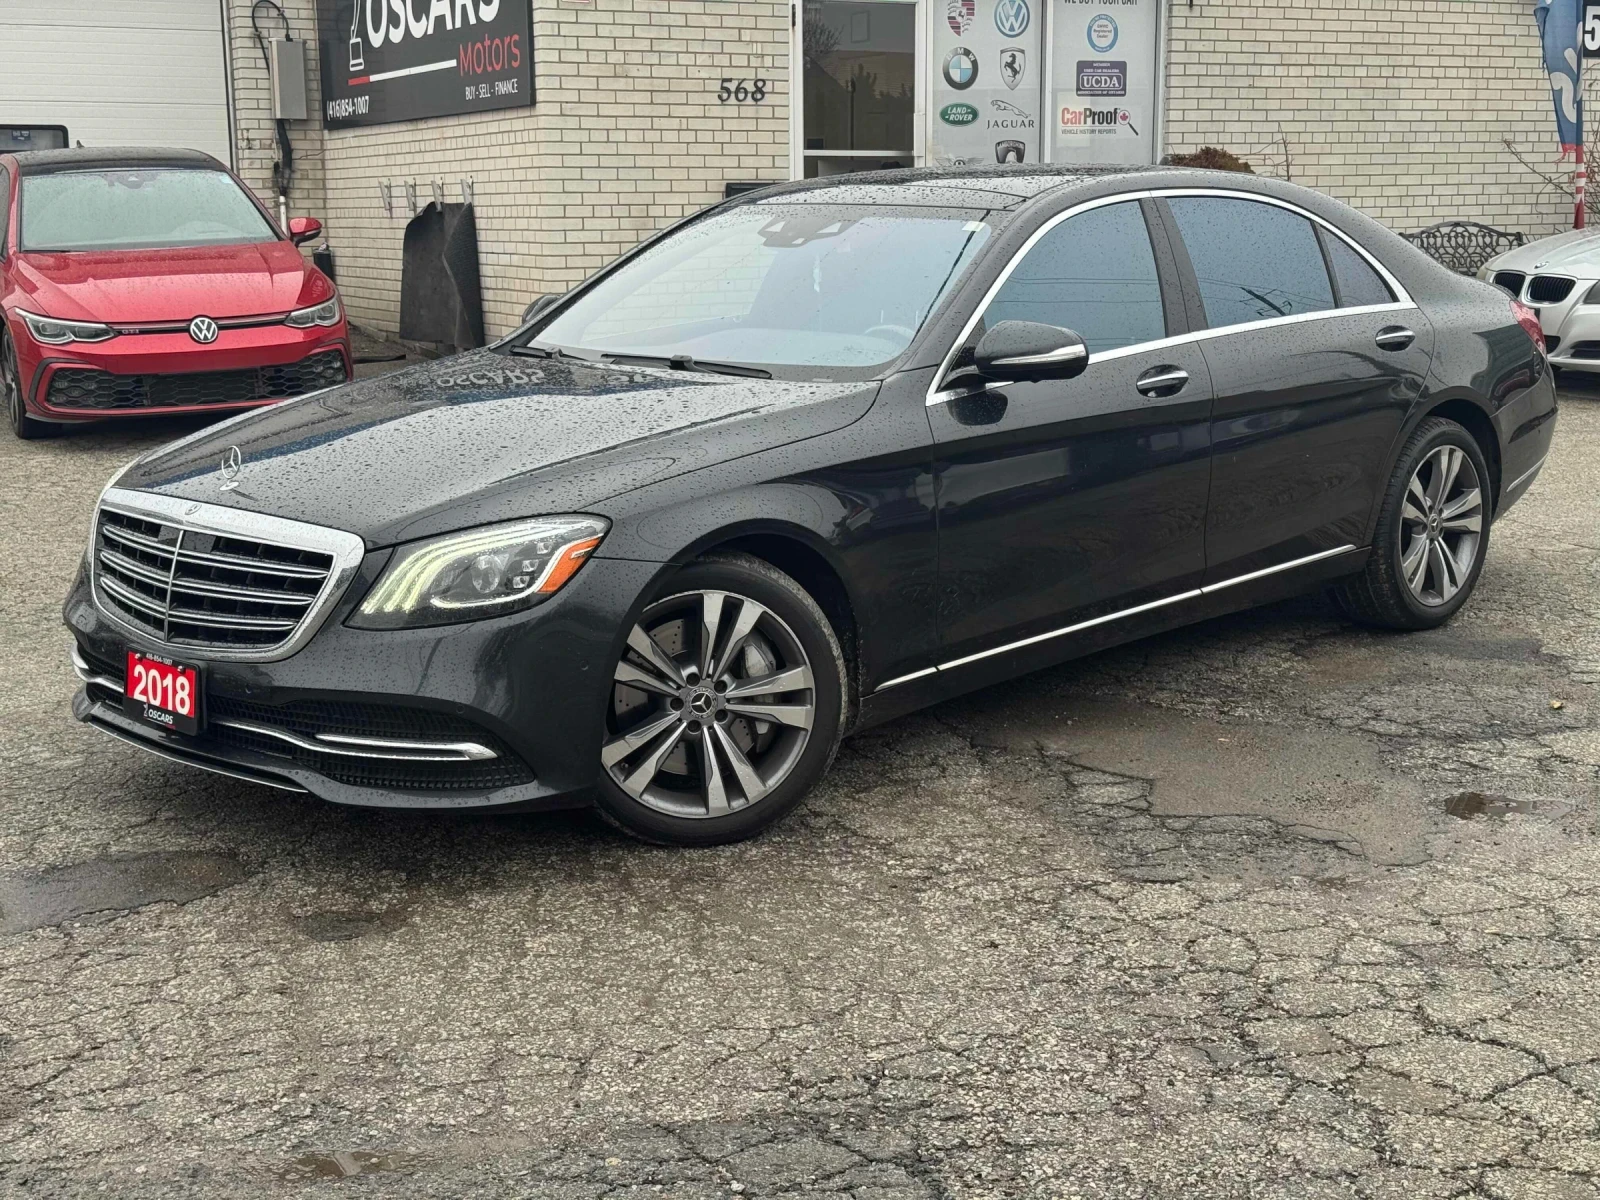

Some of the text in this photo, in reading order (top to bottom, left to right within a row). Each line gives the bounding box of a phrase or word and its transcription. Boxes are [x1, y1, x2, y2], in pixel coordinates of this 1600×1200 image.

[459, 33, 520, 77] Motors
[465, 78, 518, 100] BUY SELL FINANCE
[717, 77, 767, 103] 568
[1083, 76, 1120, 88] UCDA
[326, 95, 370, 121] (416)854-1007
[1061, 107, 1118, 125] CarProof
[986, 119, 1035, 130] JAGUAR
[133, 664, 191, 716] 2018
[148, 709, 174, 724] OSCARS
